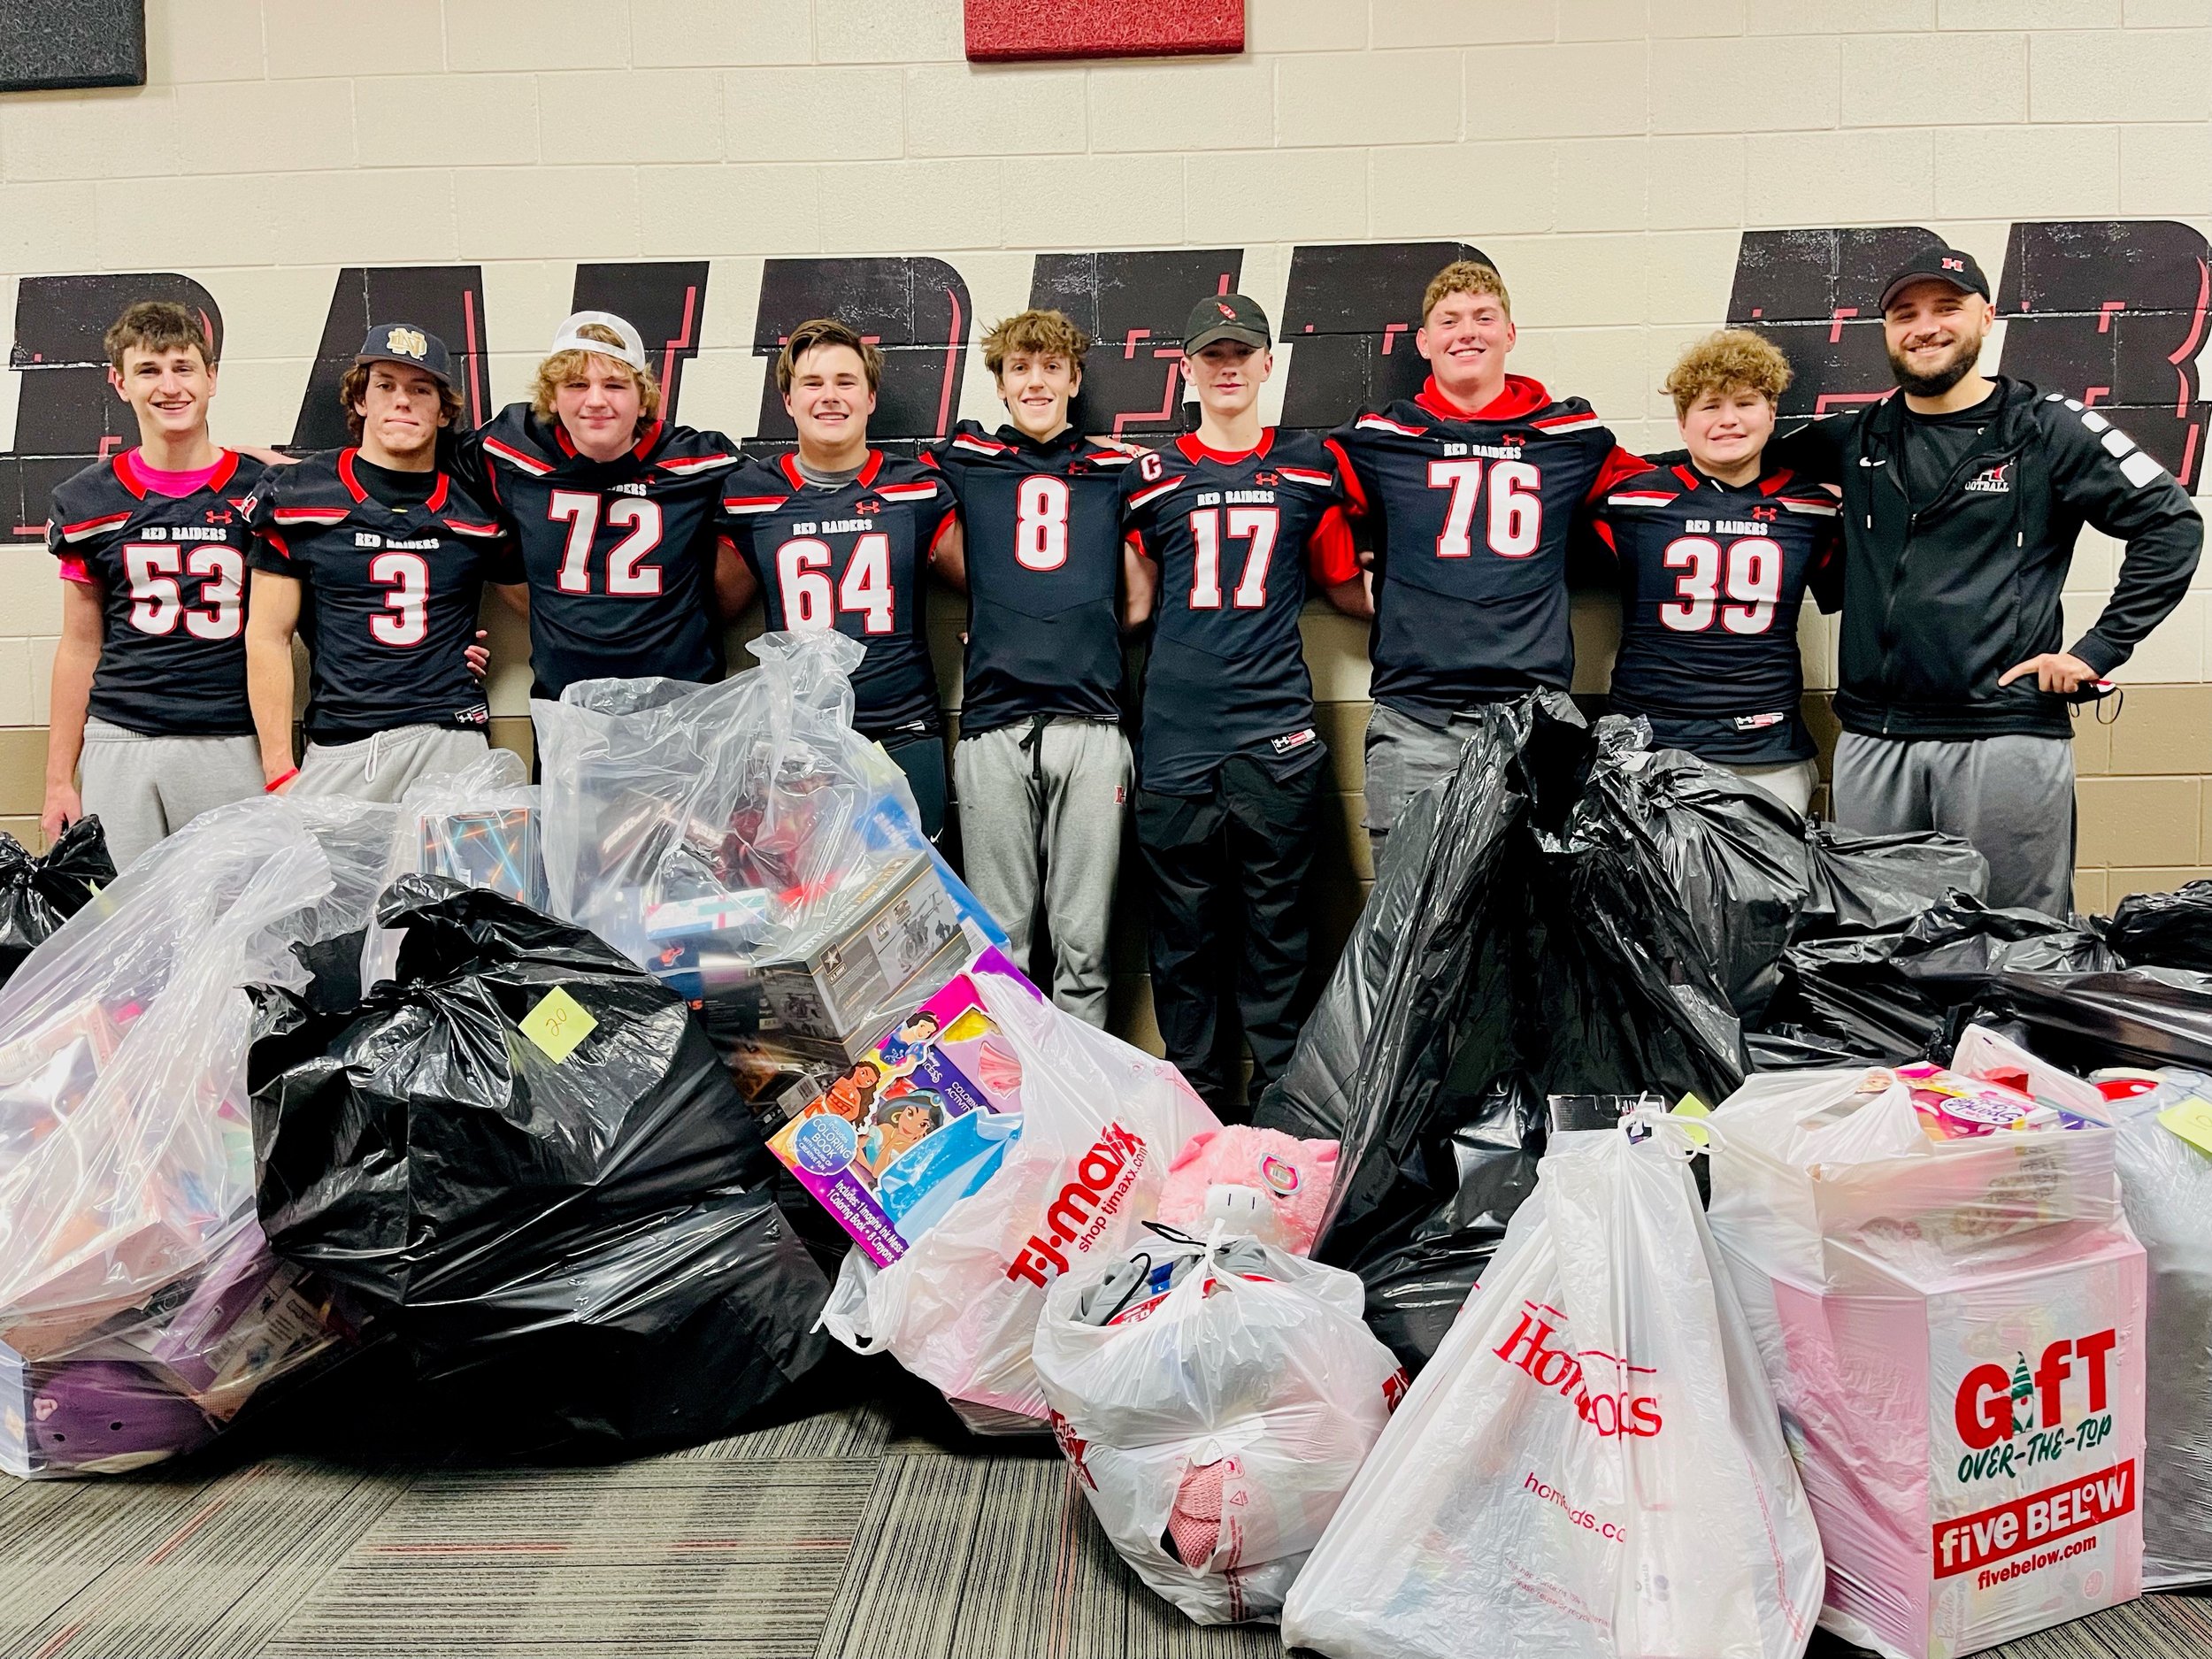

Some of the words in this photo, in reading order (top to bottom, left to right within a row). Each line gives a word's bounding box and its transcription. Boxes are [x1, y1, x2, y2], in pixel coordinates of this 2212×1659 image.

[1443, 443, 1468, 457] RED
[1472, 444, 1522, 459] RAIDERS
[1140, 453, 1163, 482] C
[1197, 492, 1221, 506] RED
[1225, 490, 1275, 504] RAIDERS
[1964, 481, 2009, 492] OOTBALL
[1427, 457, 1543, 558] 76
[142, 527, 167, 541] RED
[172, 527, 227, 541] RAIDERS
[793, 522, 817, 536] RED
[821, 518, 873, 534] RAIDERS
[1014, 473, 1071, 572] 8
[1685, 519, 1710, 534] RED
[1715, 520, 1768, 536] RAIDERS
[355, 533, 381, 548] RED
[548, 489, 663, 595] 72
[1189, 507, 1279, 610] 17
[123, 543, 245, 641] 53
[776, 533, 895, 634] 64
[1659, 535, 1784, 635] 39
[369, 551, 429, 648] 3
[545, 1008, 567, 1037] 20
[803, 1135, 814, 1148] WITH
[812, 1146, 827, 1163] HOURS
[811, 1133, 837, 1159] BOOK
[812, 1118, 852, 1159] COLORING
[798, 1142, 818, 1163] CREATIVE
[815, 1160, 827, 1171] FUN
[829, 1192, 854, 1220] Coloring
[834, 1179, 860, 1208] Includes:
[859, 1204, 882, 1231] Imagine
[878, 1225, 892, 1241] Ink
[1079, 1216, 1107, 1253] shop
[1101, 1148, 1148, 1216] tjmaxx.com
[849, 1213, 867, 1233] Book
[867, 1232, 877, 1241] 8
[871, 1236, 895, 1262] Crayons
[1957, 1414, 2112, 1483] OVER-THE-TOP
[1939, 1511, 2019, 1568] five
[2026, 1471, 2128, 1540] BELOW
[1978, 1535, 2096, 1590] fivebelow.com
